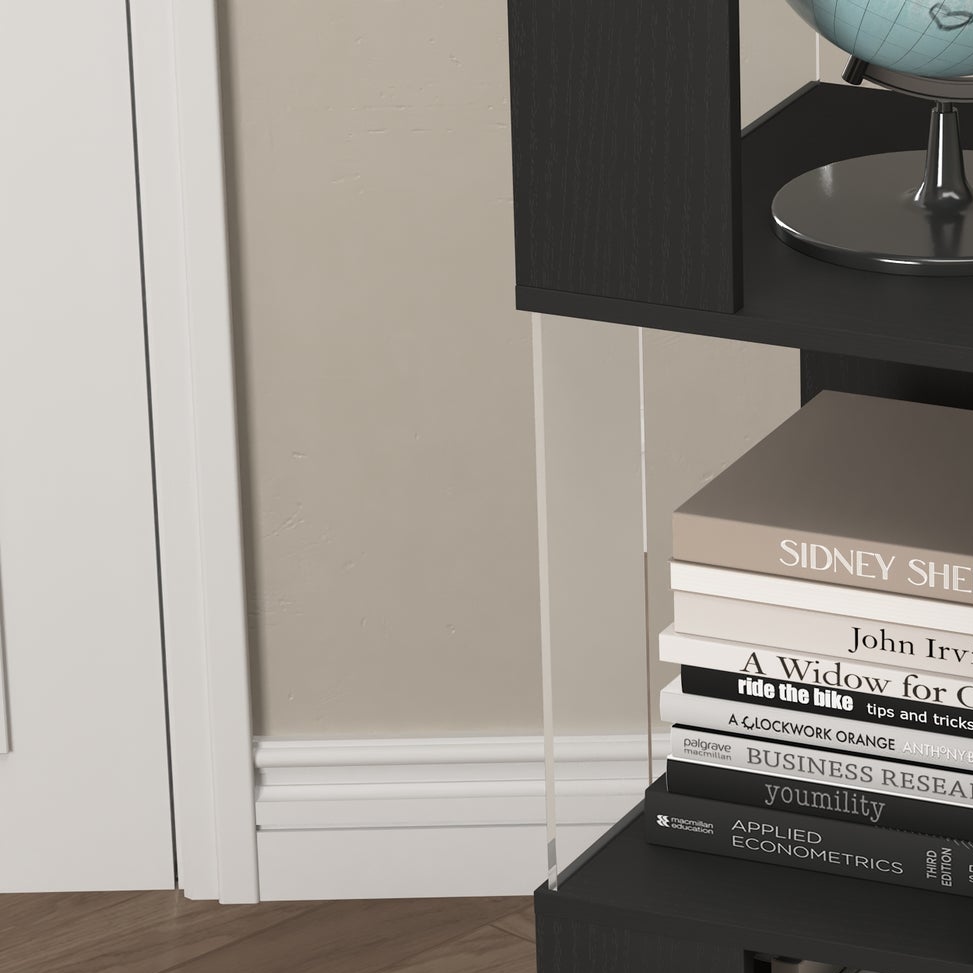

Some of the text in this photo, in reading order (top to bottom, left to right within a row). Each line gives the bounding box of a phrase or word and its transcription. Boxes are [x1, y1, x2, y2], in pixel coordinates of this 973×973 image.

[780, 539, 896, 581] SIDNEY
[848, 626, 915, 656] John
[740, 651, 766, 676] A
[776, 655, 892, 695] Widow
[901, 674, 947, 704] for
[738, 677, 775, 700] ride
[779, 682, 810, 707] the
[813, 687, 854, 712] bike
[866, 703, 895, 720] tips
[900, 708, 928, 723] and
[683, 737, 732, 754] palgrave
[728, 713, 739, 727] A
[741, 715, 832, 741] CLOCKWORK
[836, 730, 896, 751] ORANGE
[683, 748, 732, 762] macmillan
[747, 747, 874, 784] BUSINESS
[764, 783, 886, 823] youmility
[671, 817, 714, 829] macmillan
[671, 823, 714, 835] education
[731, 819, 823, 844] APPLIED
[732, 835, 904, 875] ECONOMETRICS
[926, 850, 938, 880] THIRD
[941, 847, 953, 887] EDITION
